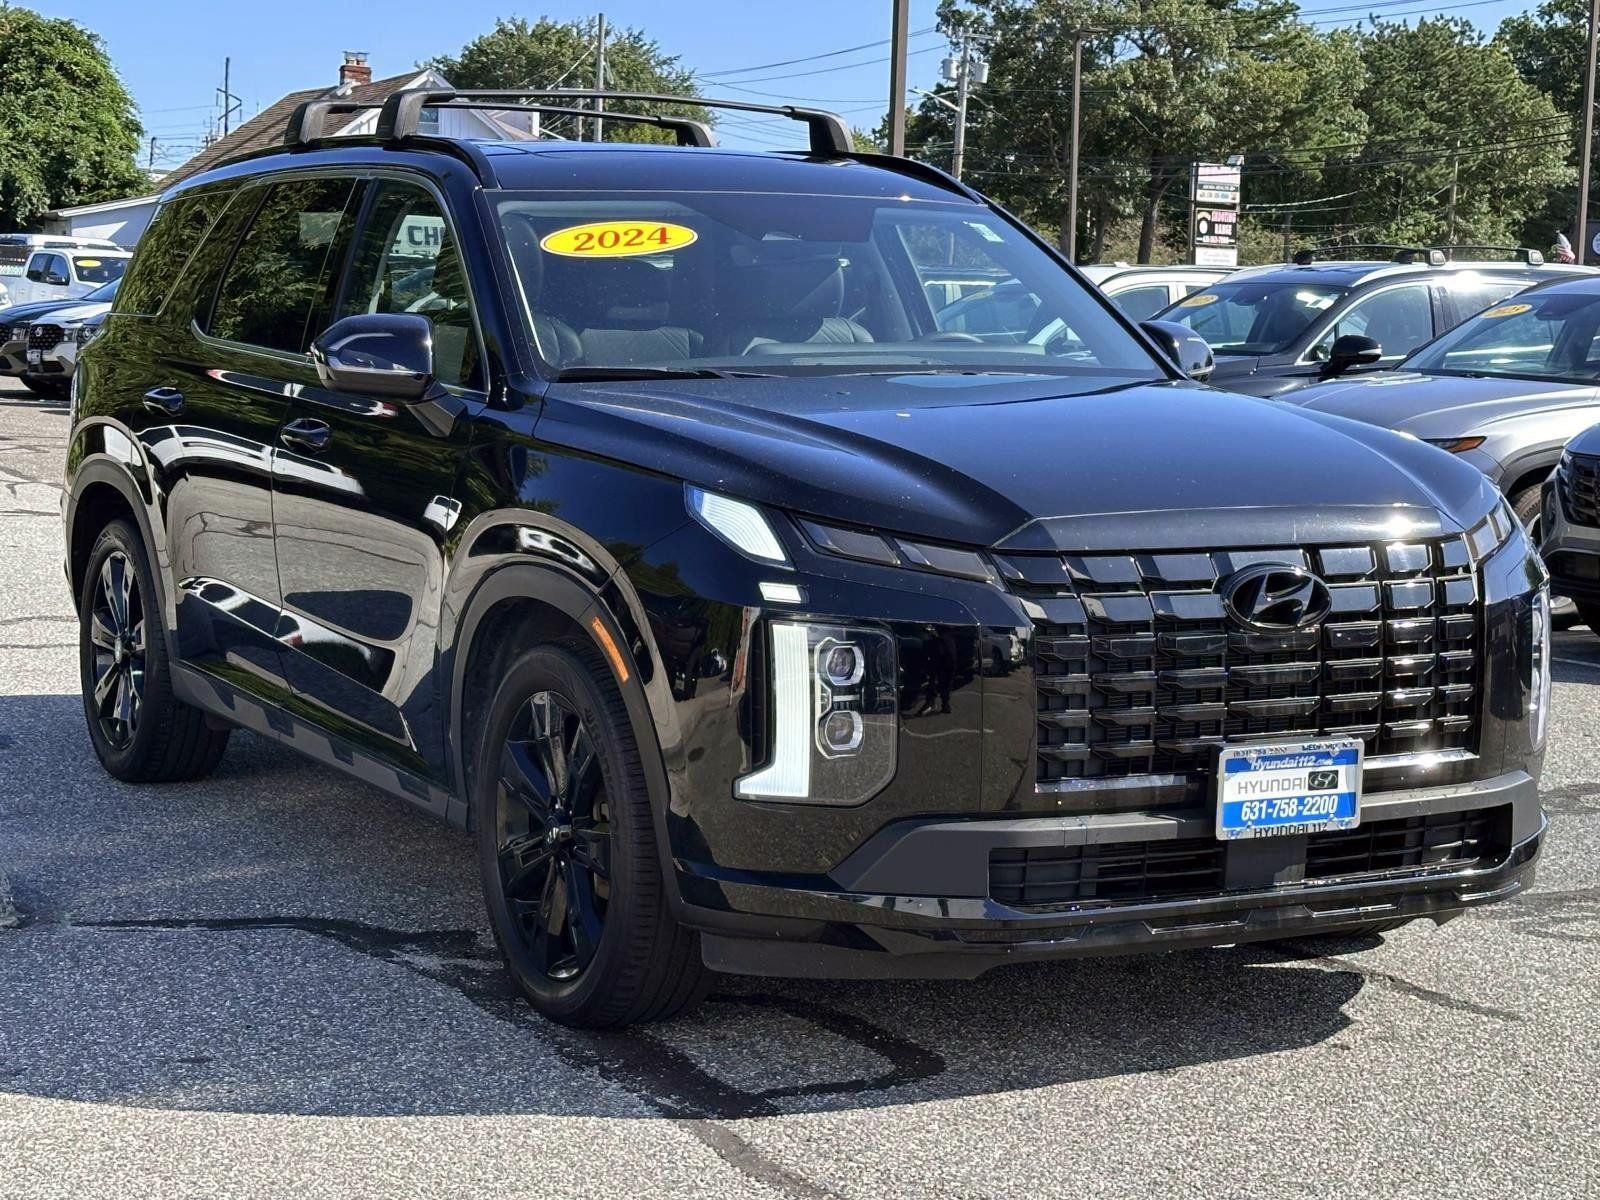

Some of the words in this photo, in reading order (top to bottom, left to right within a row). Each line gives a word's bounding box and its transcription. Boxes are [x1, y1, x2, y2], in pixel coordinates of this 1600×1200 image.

[573, 227, 672, 252] 2024
[1250, 755, 1334, 771] Hyundai112.com
[1238, 777, 1307, 795] HYUNDAI
[1241, 796, 1338, 821] 631-758-2200
[1253, 823, 1309, 839] HYUNDAI
[1312, 822, 1328, 832] 112
